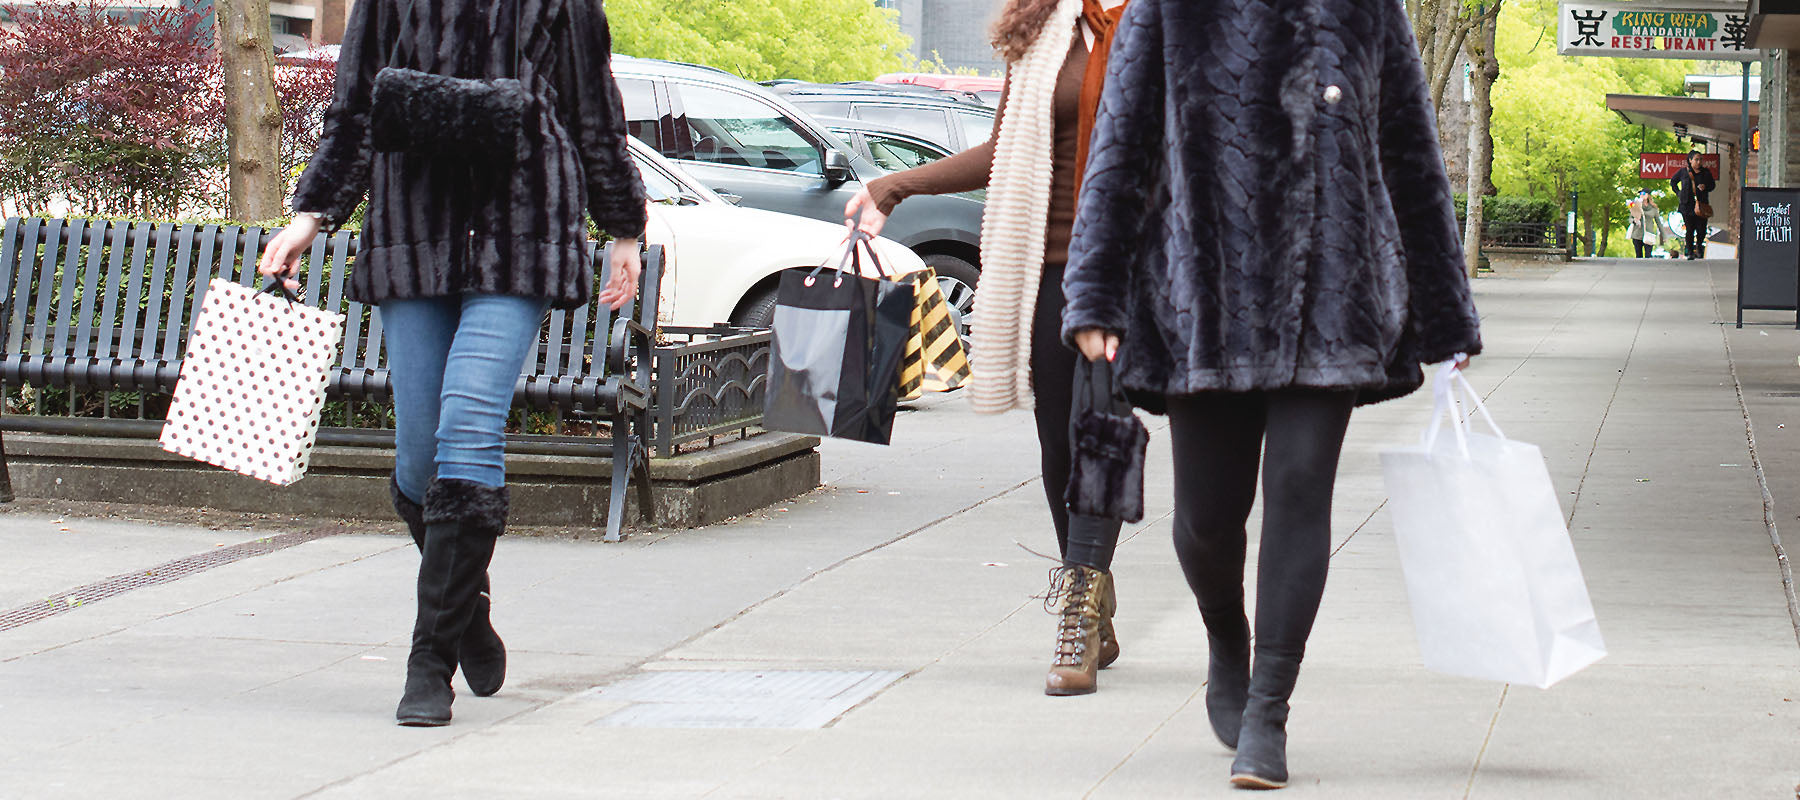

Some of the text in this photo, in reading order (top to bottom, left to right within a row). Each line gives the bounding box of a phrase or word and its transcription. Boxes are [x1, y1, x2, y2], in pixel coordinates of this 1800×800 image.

[1570, 9, 1608, 47] 京
[1622, 12, 1708, 30] KING WHA
[1632, 26, 1696, 37] MANDARIN
[1611, 36, 1717, 51] RESTURANT
[1642, 159, 1664, 173] kw
[1751, 202, 1766, 214] The
[1783, 216, 1791, 226] is
[1756, 226, 1792, 242] HEALTH
